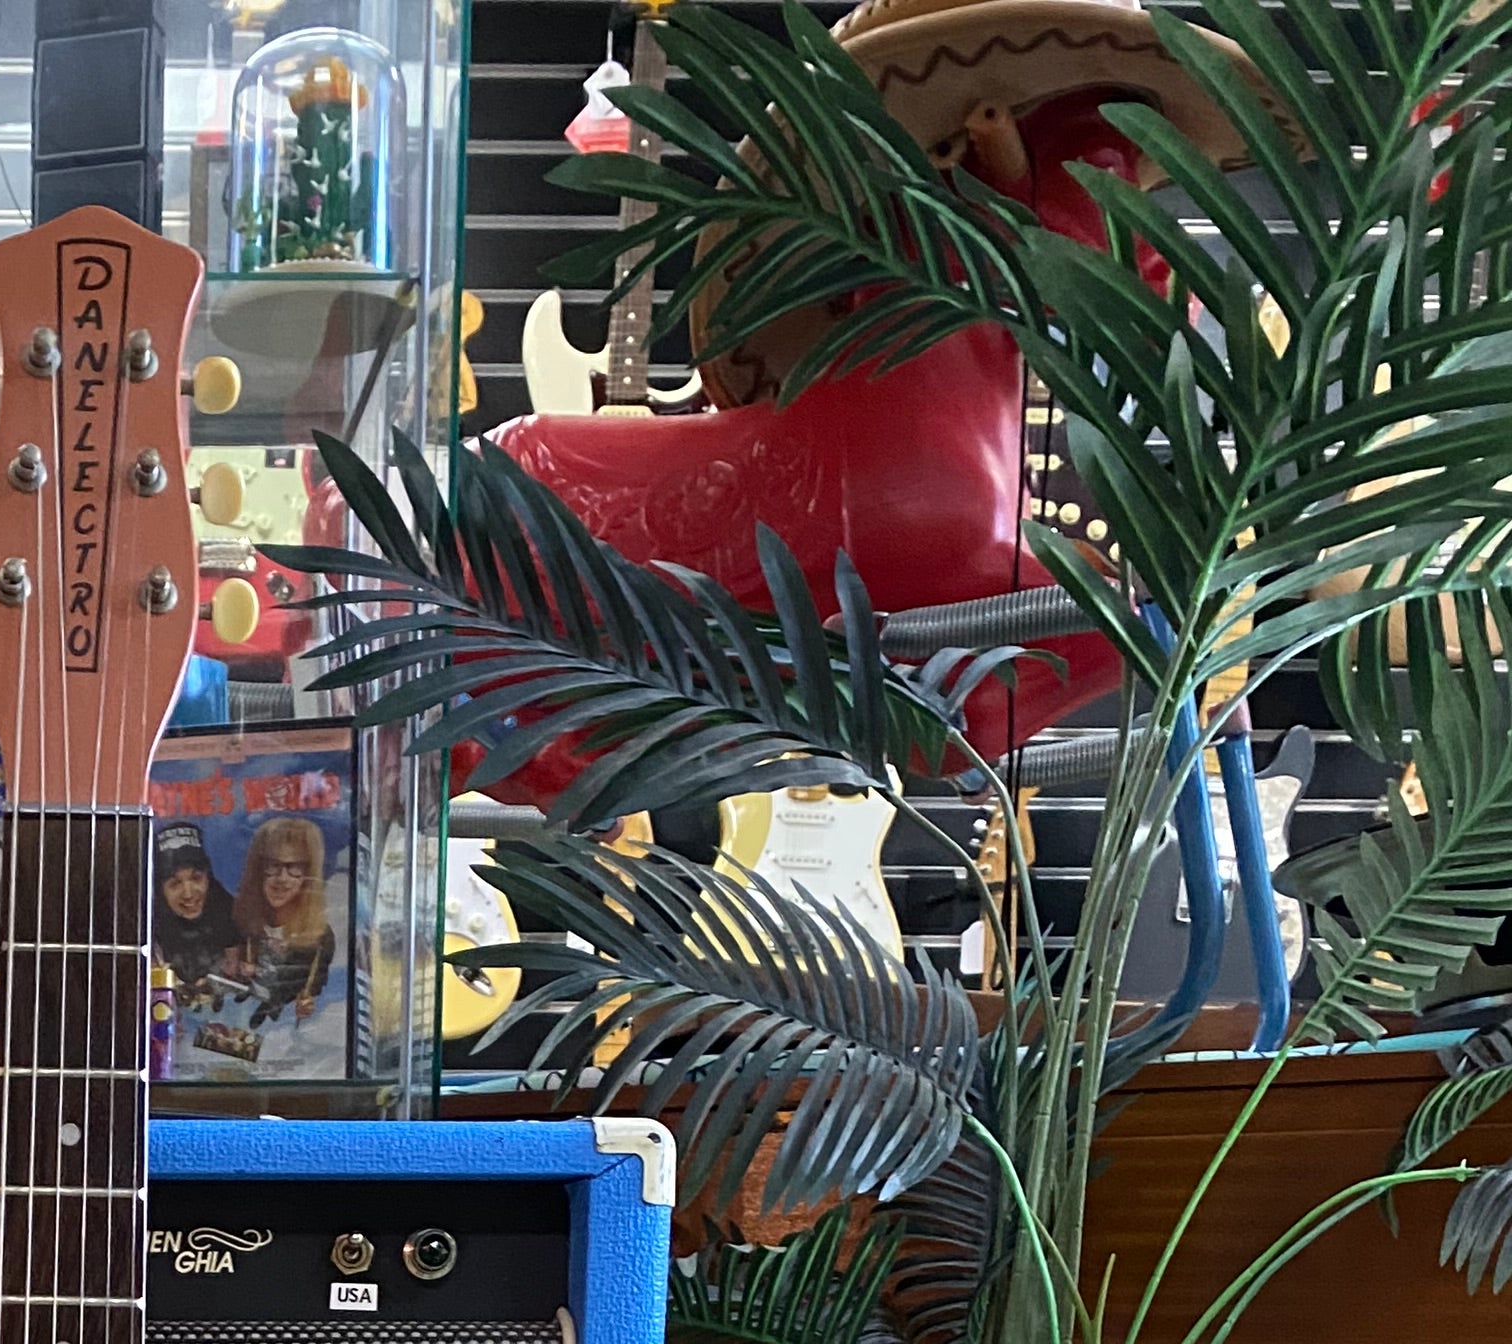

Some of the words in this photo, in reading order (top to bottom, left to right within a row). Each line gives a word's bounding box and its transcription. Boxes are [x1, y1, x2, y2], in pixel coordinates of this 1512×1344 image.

[68, 255, 113, 657] DANELECTRO
[149, 768, 234, 817] AYNE'S
[148, 1230, 183, 1253] EN
[174, 1251, 235, 1274] GHIA
[337, 1286, 372, 1304] USA
